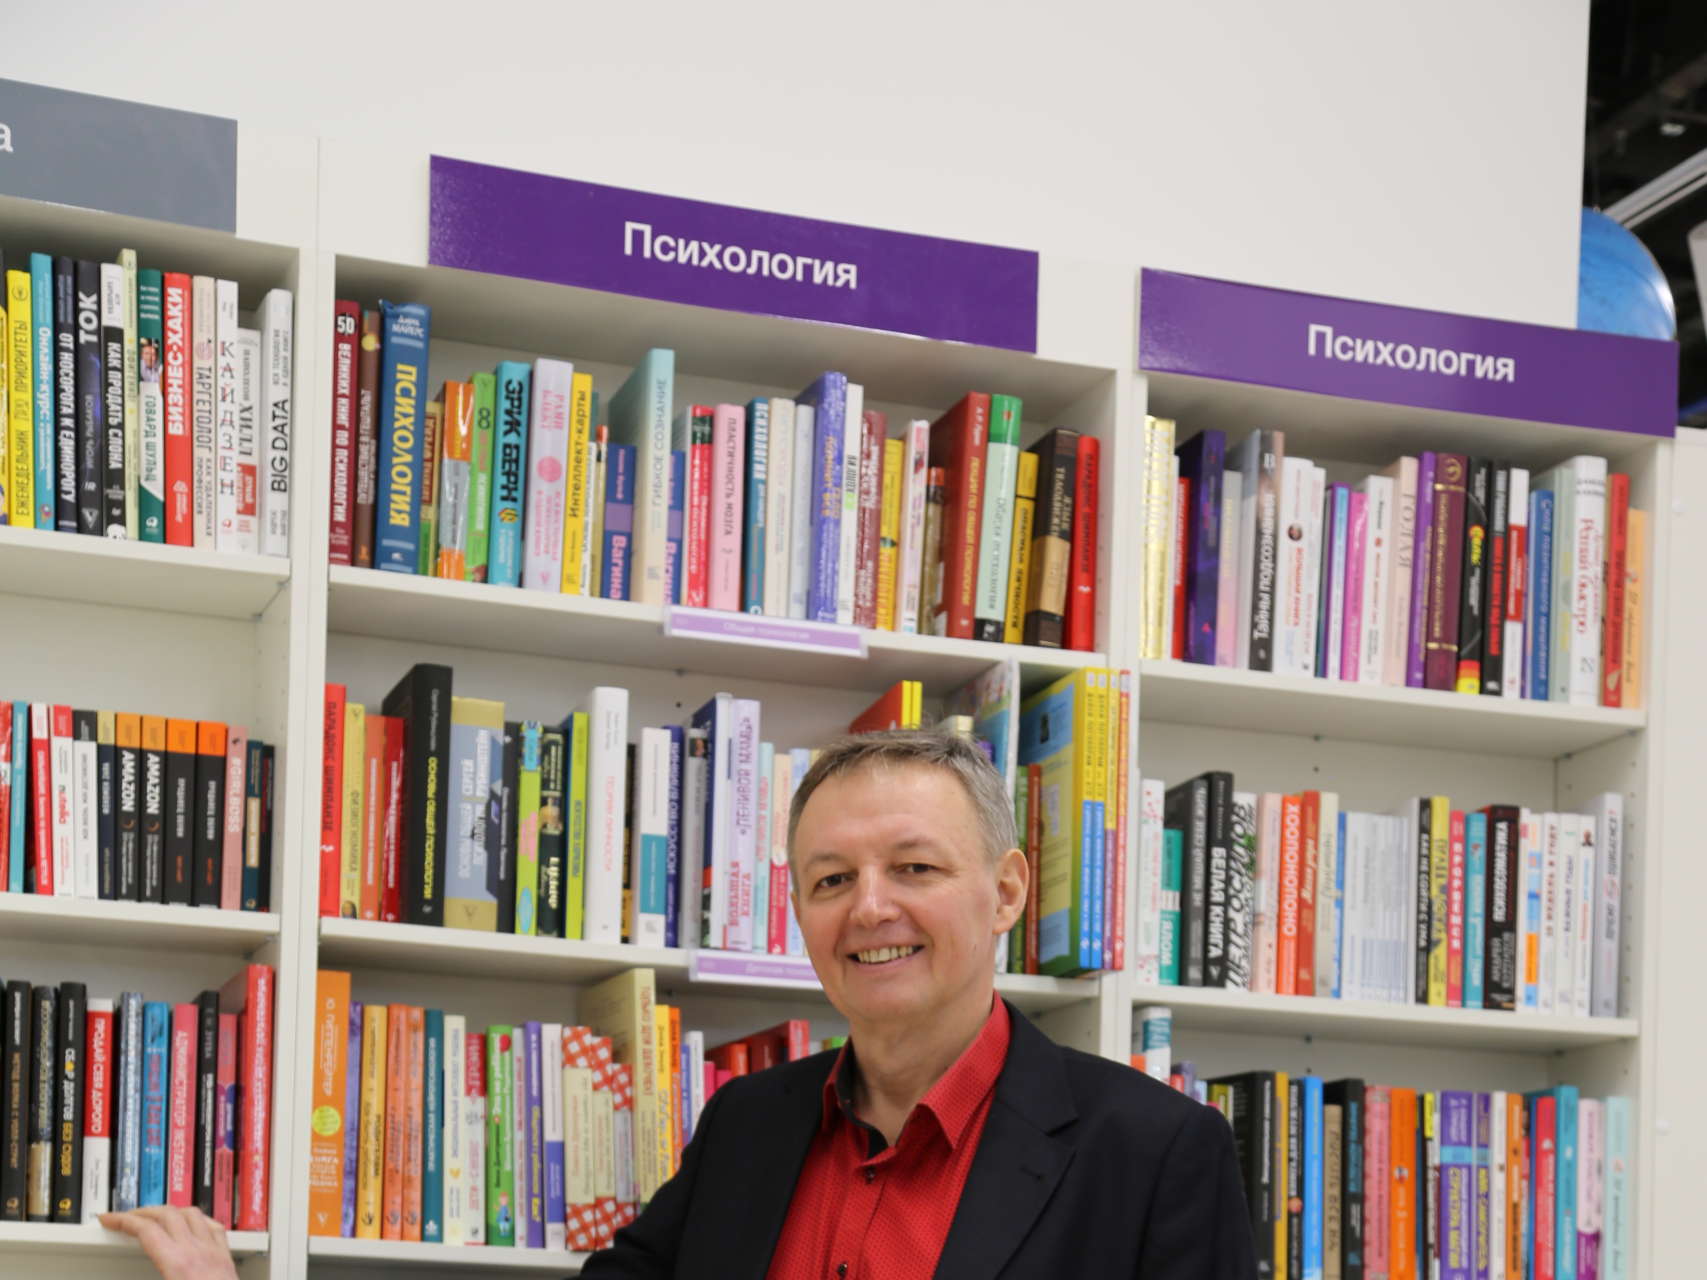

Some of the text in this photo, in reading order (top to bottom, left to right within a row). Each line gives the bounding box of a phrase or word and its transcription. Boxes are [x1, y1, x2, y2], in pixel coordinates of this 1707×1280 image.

[624, 220, 858, 289] Психология
[59, 333, 73, 348] ОТ
[79, 292, 97, 344] ТОК
[59, 352, 74, 414] НОСОРОГА
[1308, 323, 1515, 383] Психология
[61, 418, 74, 427] К
[107, 342, 122, 469] КАК ПРОДАТЬ СЛОНА
[143, 394, 157, 482] ГОВАРД ШУЛЬЦ
[196, 366, 212, 452] ТАРГЕТОЛОГ
[273, 399, 289, 450] DATA
[334, 315, 356, 522] 50 ВЕЛИКИХ КНИГ ПО ПСИХОЛОГИИ
[60, 430, 75, 502] ЕДИНОРОГУ
[272, 454, 287, 492] BIG
[389, 363, 417, 527] ПСИХОЛОГИЯ
[500, 443, 519, 502] БЕРН
[569, 391, 586, 517] Интеллект-карты
[651, 378, 667, 507] ГИБКОЕ СОЗНАНИЕ
[723, 417, 737, 535] ПЛАСТИЧНОСТЬ МОЗГА
[610, 535, 626, 600] Вагина
[1253, 593, 1269, 640] Тайны
[121, 750, 135, 811] AMAZON
[146, 753, 160, 815] AMAZON
[323, 702, 337, 832] ПАРАДОКС ШИМПАНЗЕ
[1209, 847, 1226, 958] БЕЛАЯ КНИГА
[1283, 803, 1300, 937] ХООПОНОПОНО
